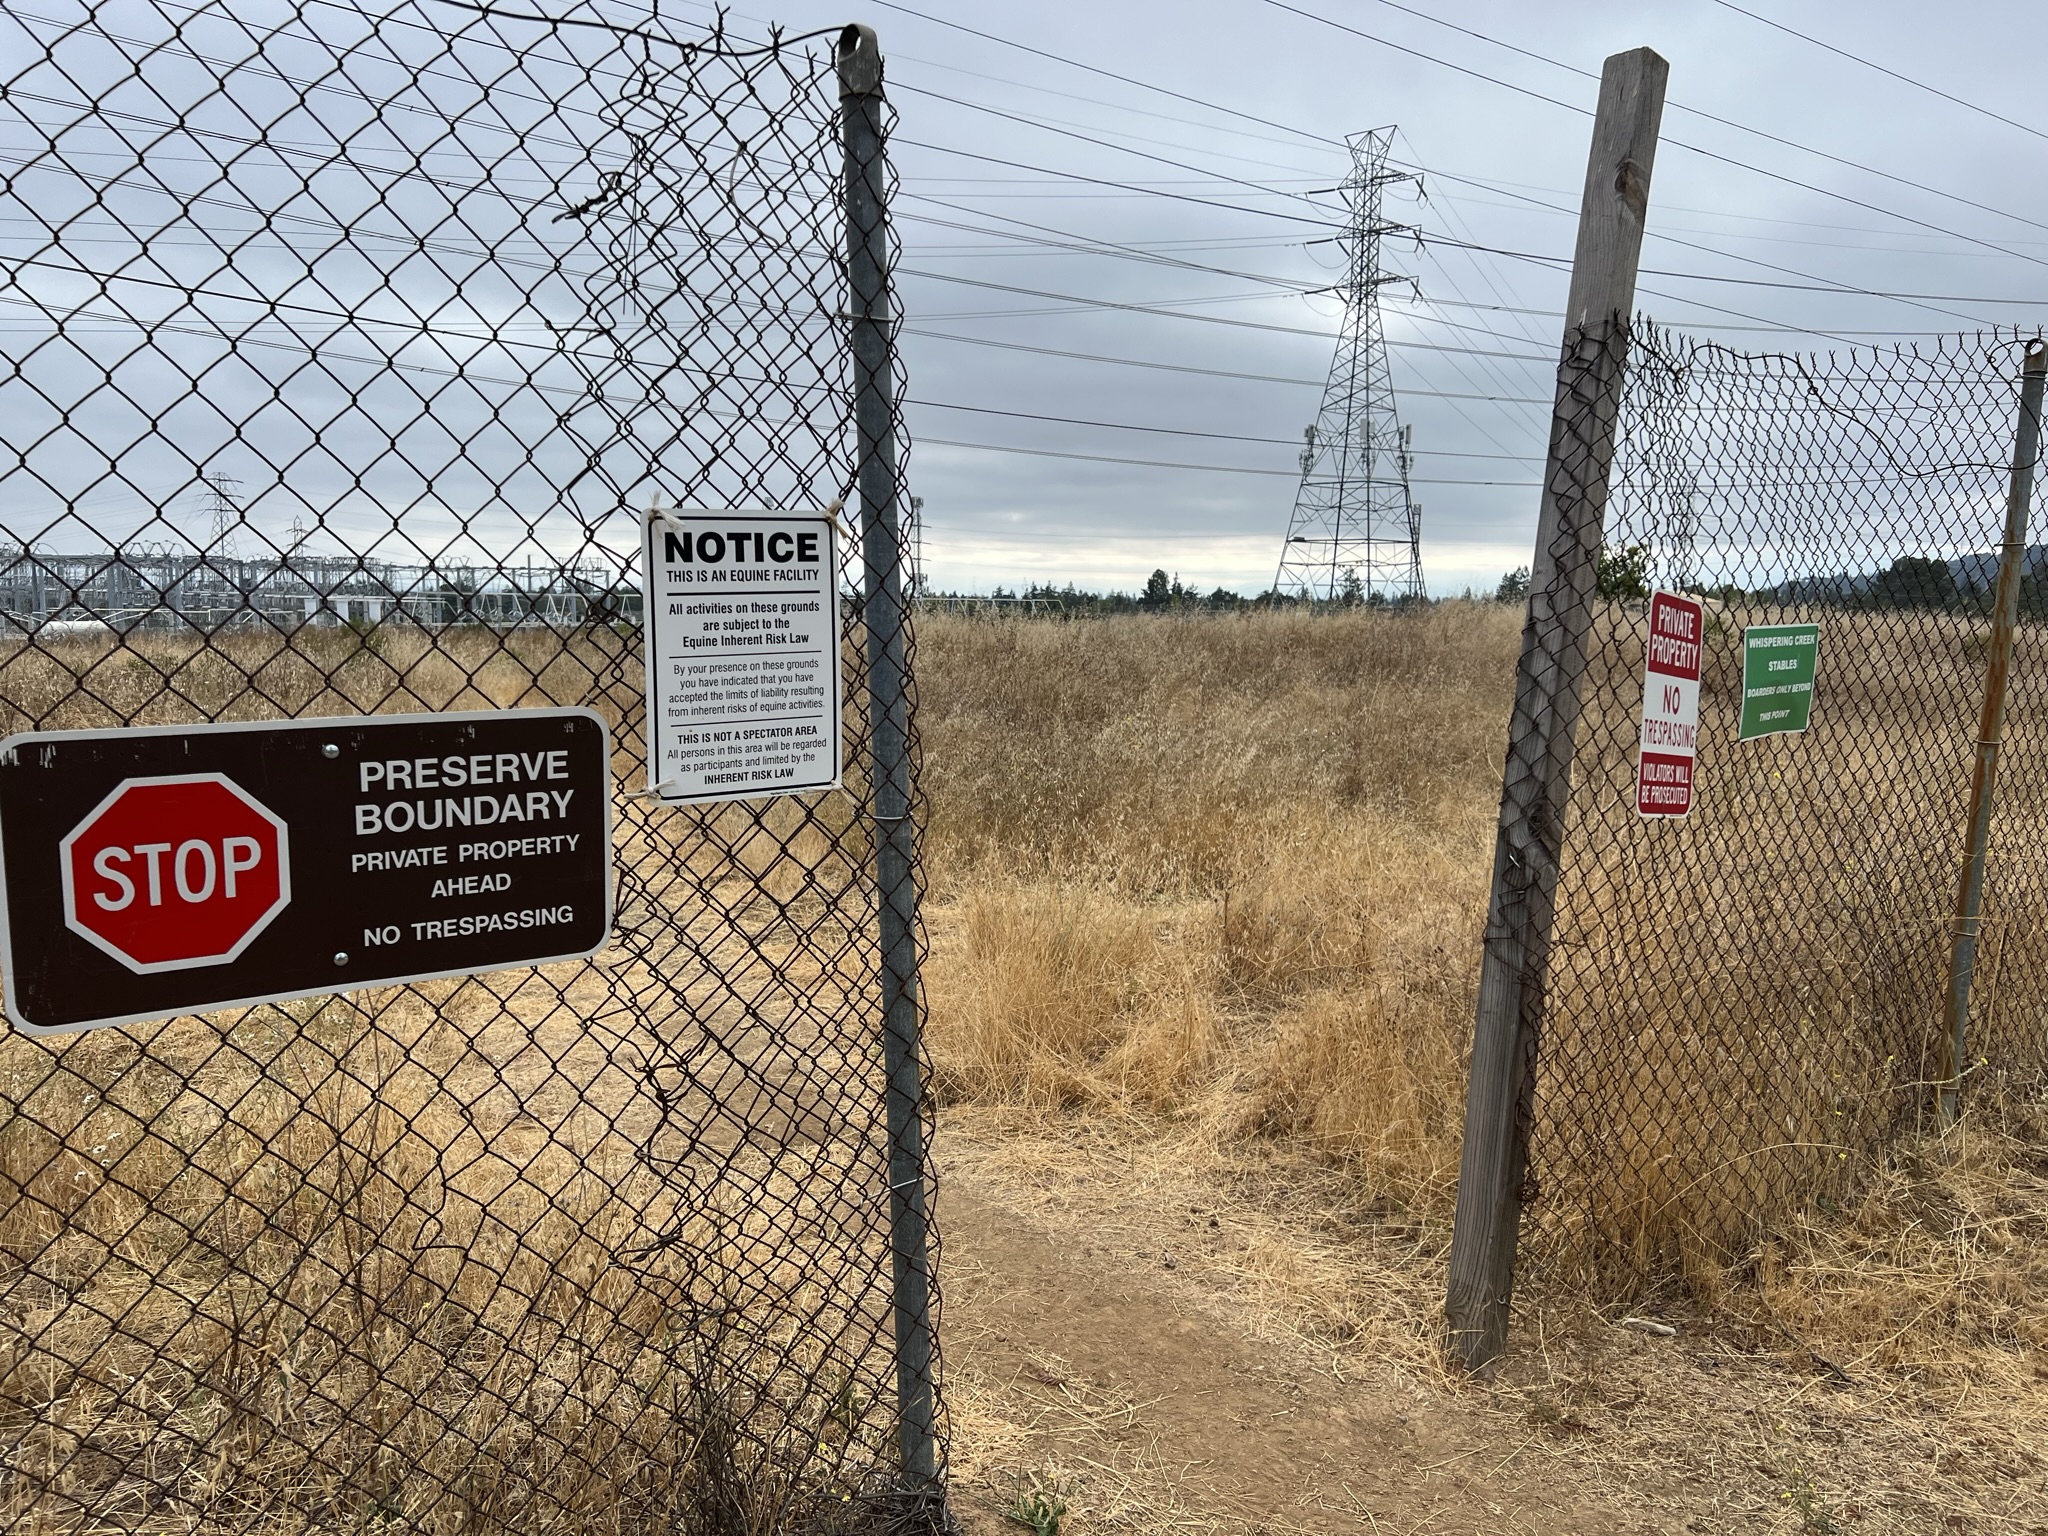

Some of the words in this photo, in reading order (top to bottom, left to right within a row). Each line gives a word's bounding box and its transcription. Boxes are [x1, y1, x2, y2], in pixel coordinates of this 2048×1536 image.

[665, 532, 819, 563] NOTICE
[667, 570, 693, 582] THIS
[697, 570, 707, 582] IS
[712, 570, 726, 582] AN
[731, 570, 770, 582] EQUINE
[774, 569, 819, 581] FACILITY
[669, 604, 682, 615] All
[687, 603, 732, 614] activities
[736, 605, 748, 613] on
[751, 602, 778, 613] these
[781, 601, 819, 614] grounds
[703, 622, 719, 631] are
[723, 619, 759, 632] subject
[762, 620, 771, 629] to
[775, 619, 790, 628] the
[1658, 604, 1694, 639] PRIVATE
[683, 636, 717, 649] Equine
[721, 634, 763, 646] Inherent
[766, 634, 786, 644] Risk
[790, 633, 809, 643] Law
[1749, 636, 1793, 648] WHISPERING
[1795, 635, 1815, 645] CREEK
[1651, 634, 1698, 670] PROPERTY
[674, 665, 685, 676] By
[687, 666, 706, 676] your
[710, 663, 747, 674] presence
[750, 663, 760, 671] on
[763, 661, 784, 670] these
[787, 659, 819, 670] grounds
[1768, 660, 1797, 671] STABLES
[680, 680, 696, 690] you
[699, 677, 719, 687] have
[721, 675, 758, 686] indicated
[761, 675, 776, 684] that
[778, 674, 793, 684] you
[795, 674, 814, 682] have
[1747, 686, 1776, 698] BOARDERS
[1777, 685, 1791, 694] ONLY
[1792, 683, 1811, 693] BEYOND
[669, 692, 708, 704] accepted
[710, 692, 723, 700] the
[726, 690, 748, 699] limits
[751, 689, 758, 698] of
[761, 688, 788, 699] liability
[791, 686, 824, 697] resulting
[1663, 685, 1680, 715] NO
[668, 708, 688, 717] from
[691, 706, 725, 715] inherent
[728, 704, 747, 713] risks
[750, 703, 758, 712] of
[760, 702, 786, 712] equine
[789, 699, 825, 710] activities.
[1760, 712, 1771, 722] THIS
[1771, 710, 1790, 719] POINT
[678, 734, 699, 744] THIS
[702, 733, 710, 743] IS
[714, 732, 732, 742] NOT
[735, 731, 740, 740] A
[743, 728, 792, 740] SPECTATOR
[795, 726, 817, 736] AREA
[1644, 719, 1695, 748] TRESPASSING
[667, 750, 678, 759] All
[681, 747, 715, 760] persons
[718, 747, 725, 755] in
[728, 745, 742, 754] this
[745, 745, 762, 753] area
[765, 742, 778, 752] will
[781, 741, 790, 750] be
[793, 738, 826, 751] regarded
[360, 750, 569, 792] PRESERVE
[681, 764, 691, 772] as
[694, 759, 742, 772] participants
[745, 756, 760, 766] and
[763, 755, 788, 765] limited
[791, 754, 801, 765] by
[803, 752, 815, 762] the
[704, 771, 749, 784] INHERENT
[752, 770, 772, 780] RISK
[775, 768, 794, 779] LAW
[1644, 763, 1674, 782] VIOLATORS
[1676, 766, 1688, 783] WILL
[1641, 785, 1650, 803] BE
[1651, 786, 1687, 804] PROSECUTED
[355, 789, 574, 835] BOUNDARY
[352, 846, 448, 873] PRIVATE
[459, 834, 580, 862] PROPERTY
[93, 836, 261, 911] STOP
[431, 873, 511, 898] AHEAD
[364, 926, 400, 946] NO
[411, 905, 573, 941] TRESPASSING
